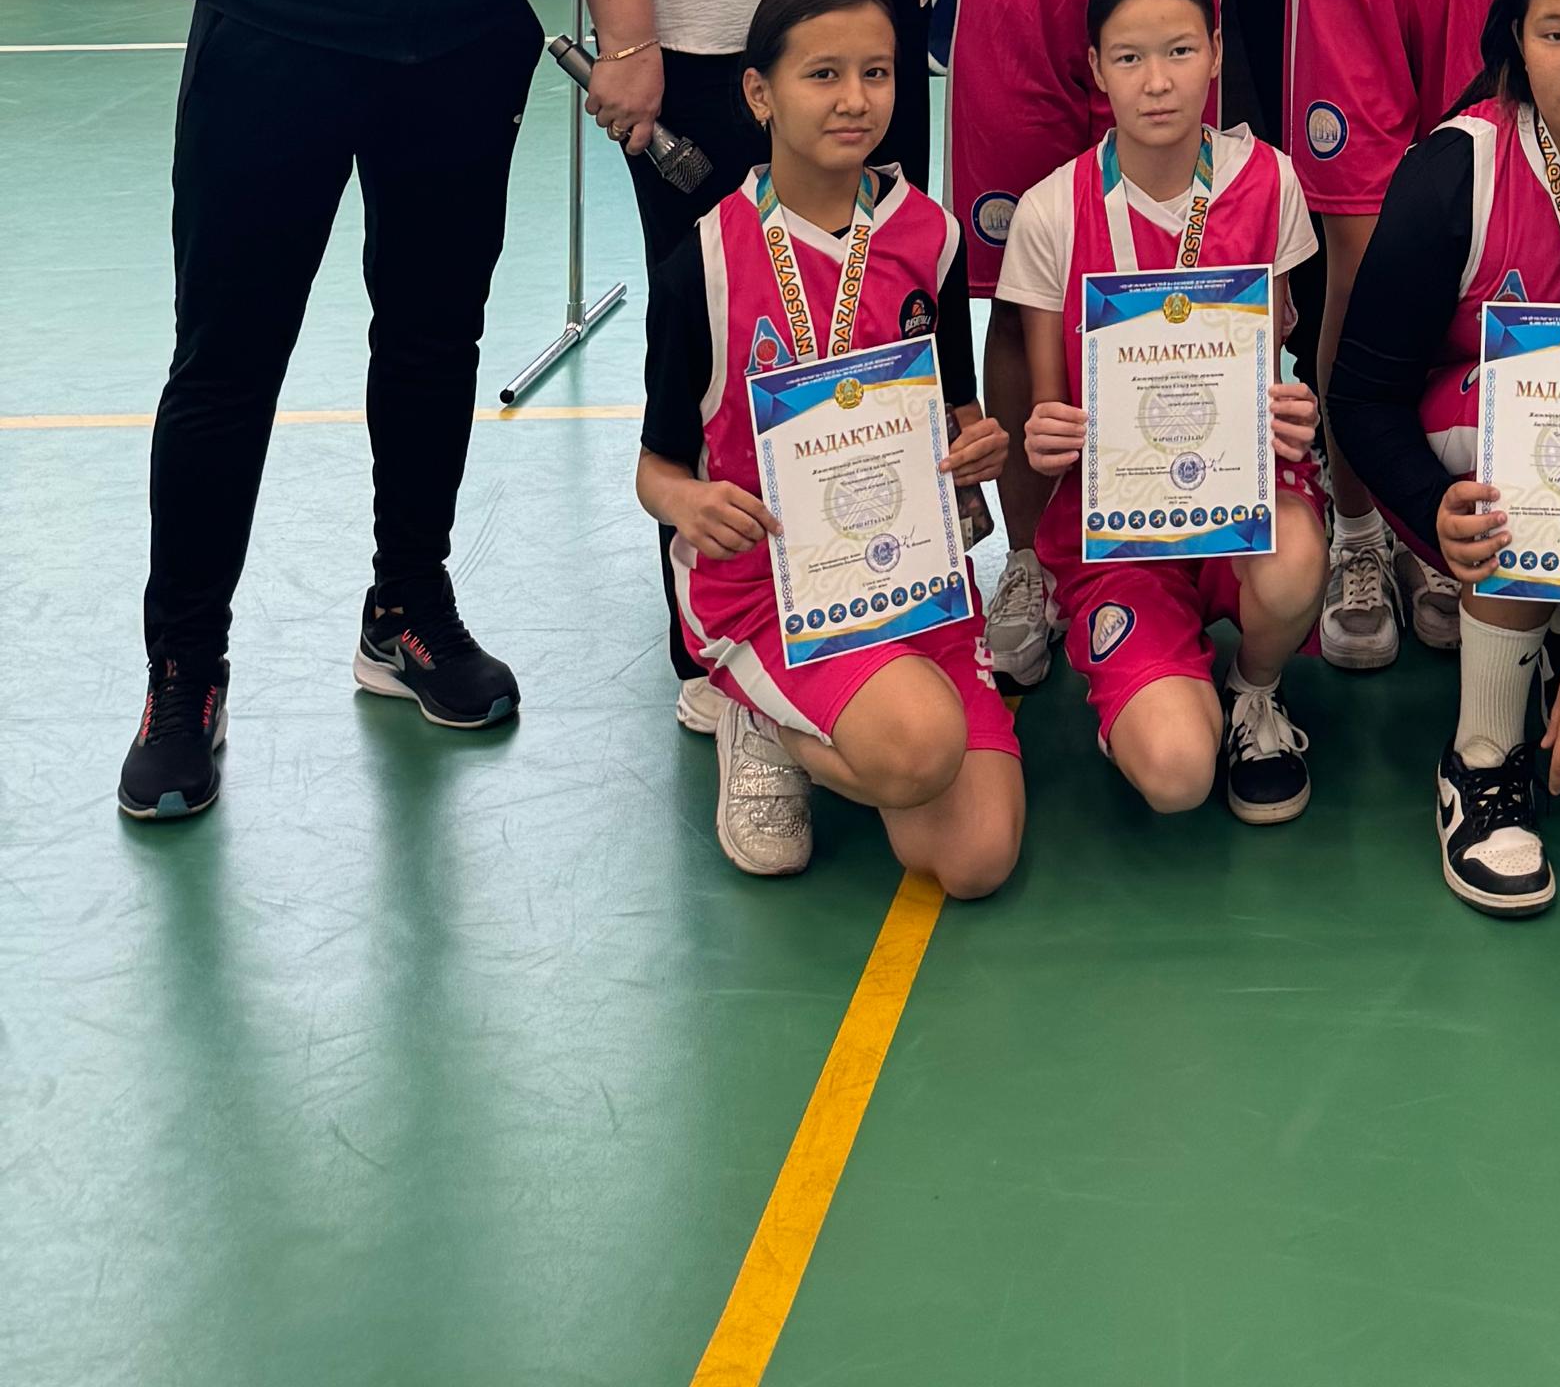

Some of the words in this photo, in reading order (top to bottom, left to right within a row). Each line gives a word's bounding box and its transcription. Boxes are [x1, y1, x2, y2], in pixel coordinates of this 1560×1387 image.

[767, 226, 814, 357] QAZAQSTAN
[833, 224, 871, 355] QAZAQSTAN
[1118, 340, 1237, 365] МАДАҚТАМА
[795, 417, 913, 462] МАДАҚТАМА
